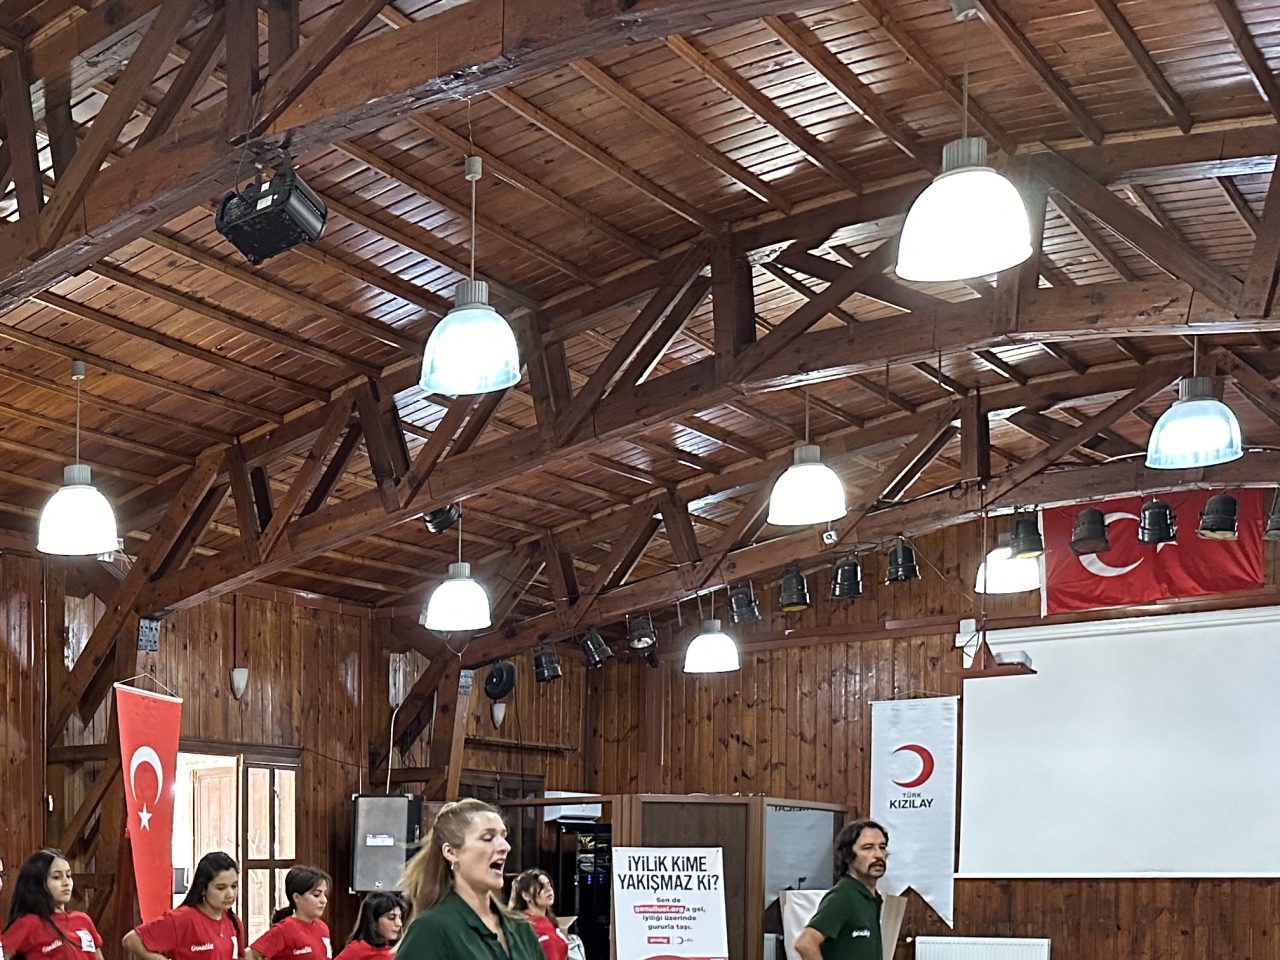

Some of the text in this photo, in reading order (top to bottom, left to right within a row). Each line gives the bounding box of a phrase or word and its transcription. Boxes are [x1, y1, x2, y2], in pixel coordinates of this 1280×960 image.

[902, 791, 922, 799] TÜRK
[889, 798, 934, 809] KIZILAY
[618, 874, 693, 894] YAKIŞMAZ
